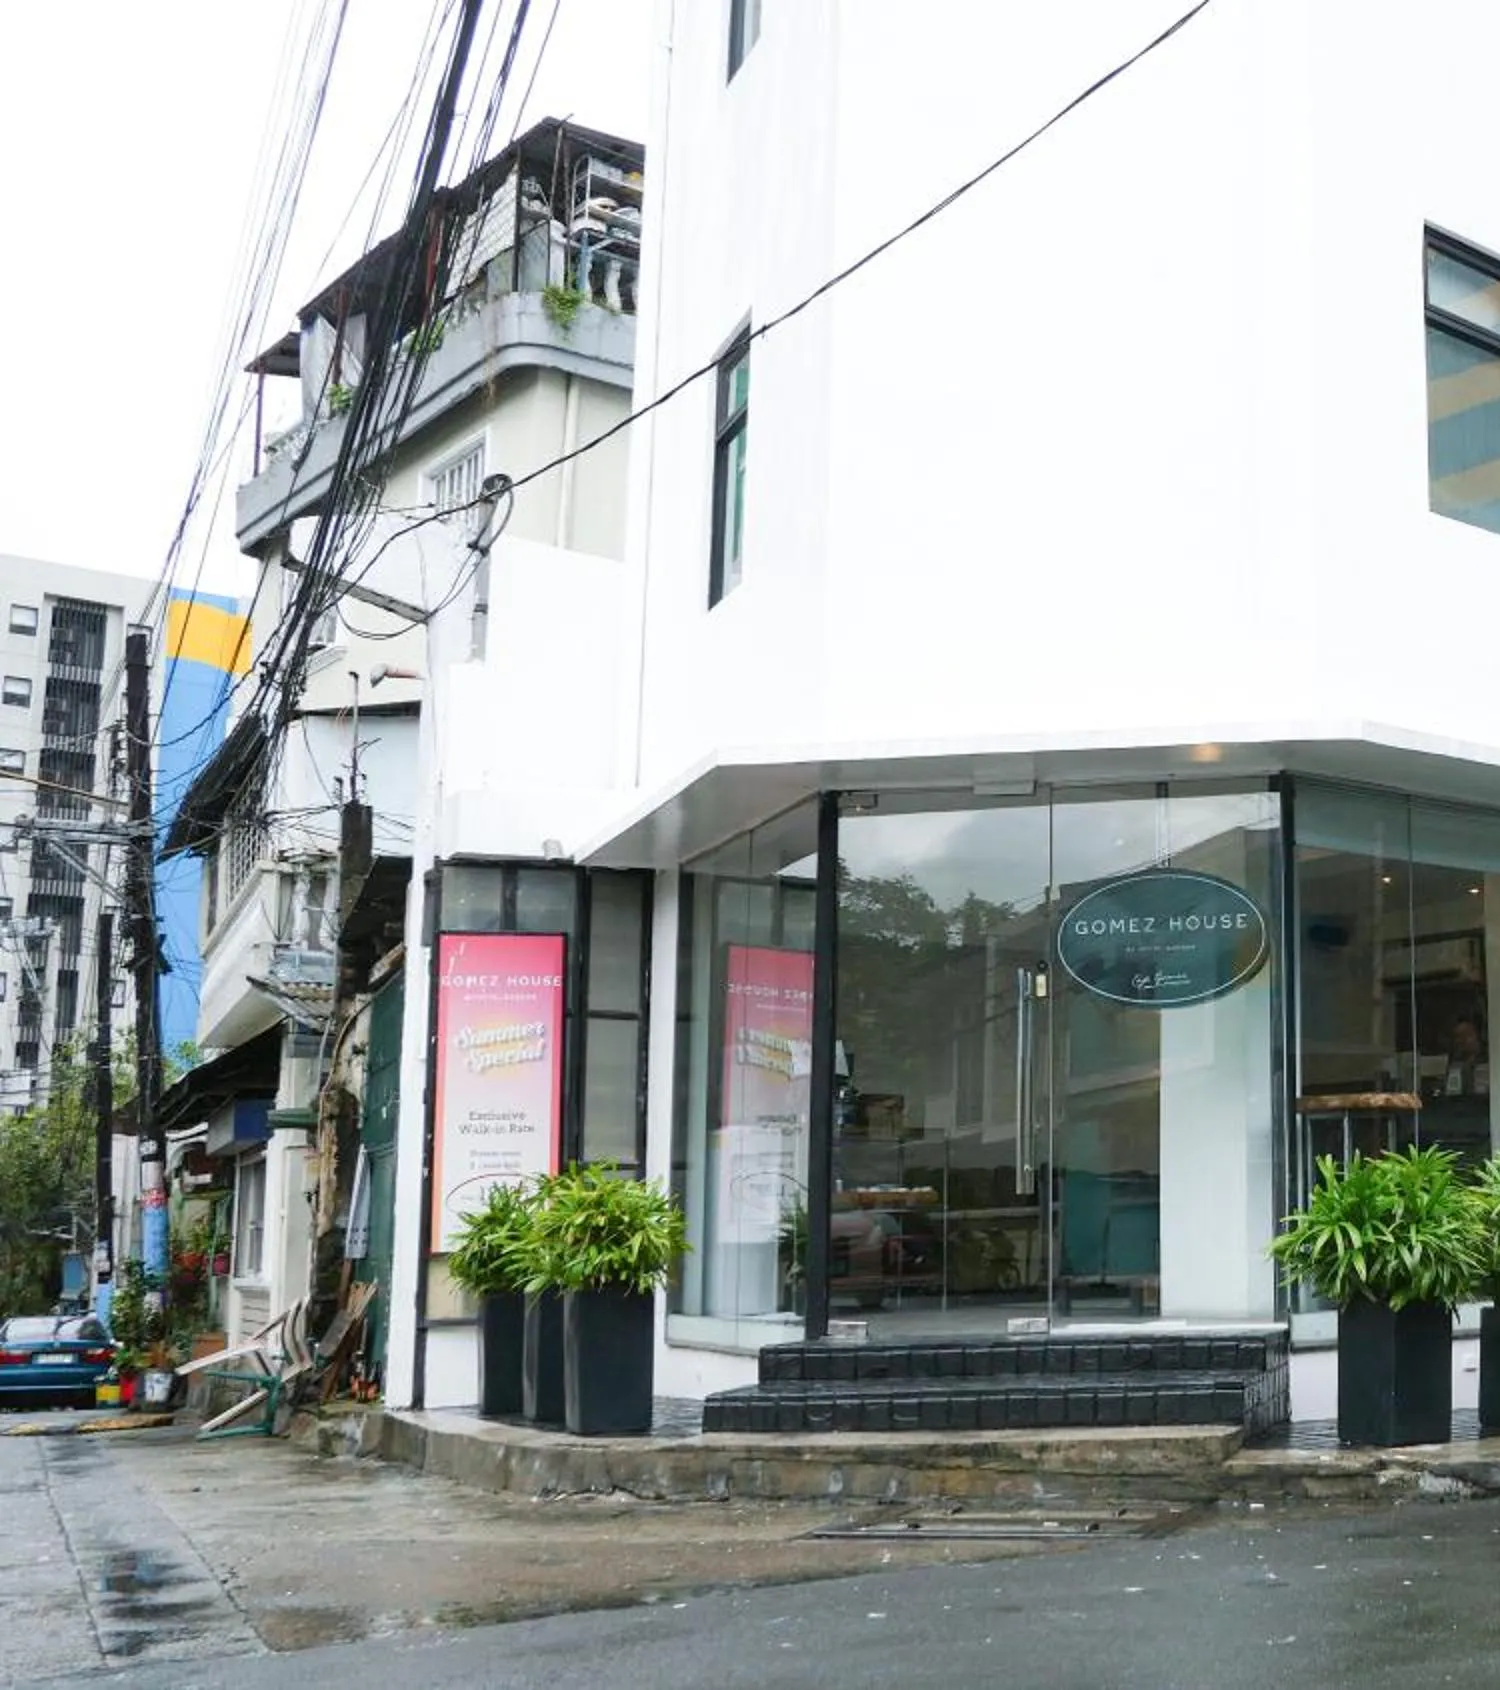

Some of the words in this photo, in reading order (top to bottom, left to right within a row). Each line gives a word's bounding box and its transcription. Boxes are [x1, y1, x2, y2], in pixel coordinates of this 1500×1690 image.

[1075, 917, 1156, 935] GOMEZ
[1169, 913, 1248, 931] HOUSE
[442, 974, 499, 987] GOMEZ
[507, 974, 563, 987] HOUSE
[454, 1023, 545, 1053] Summer
[464, 1038, 546, 1075] Special
[469, 1109, 527, 1121] Exclusive
